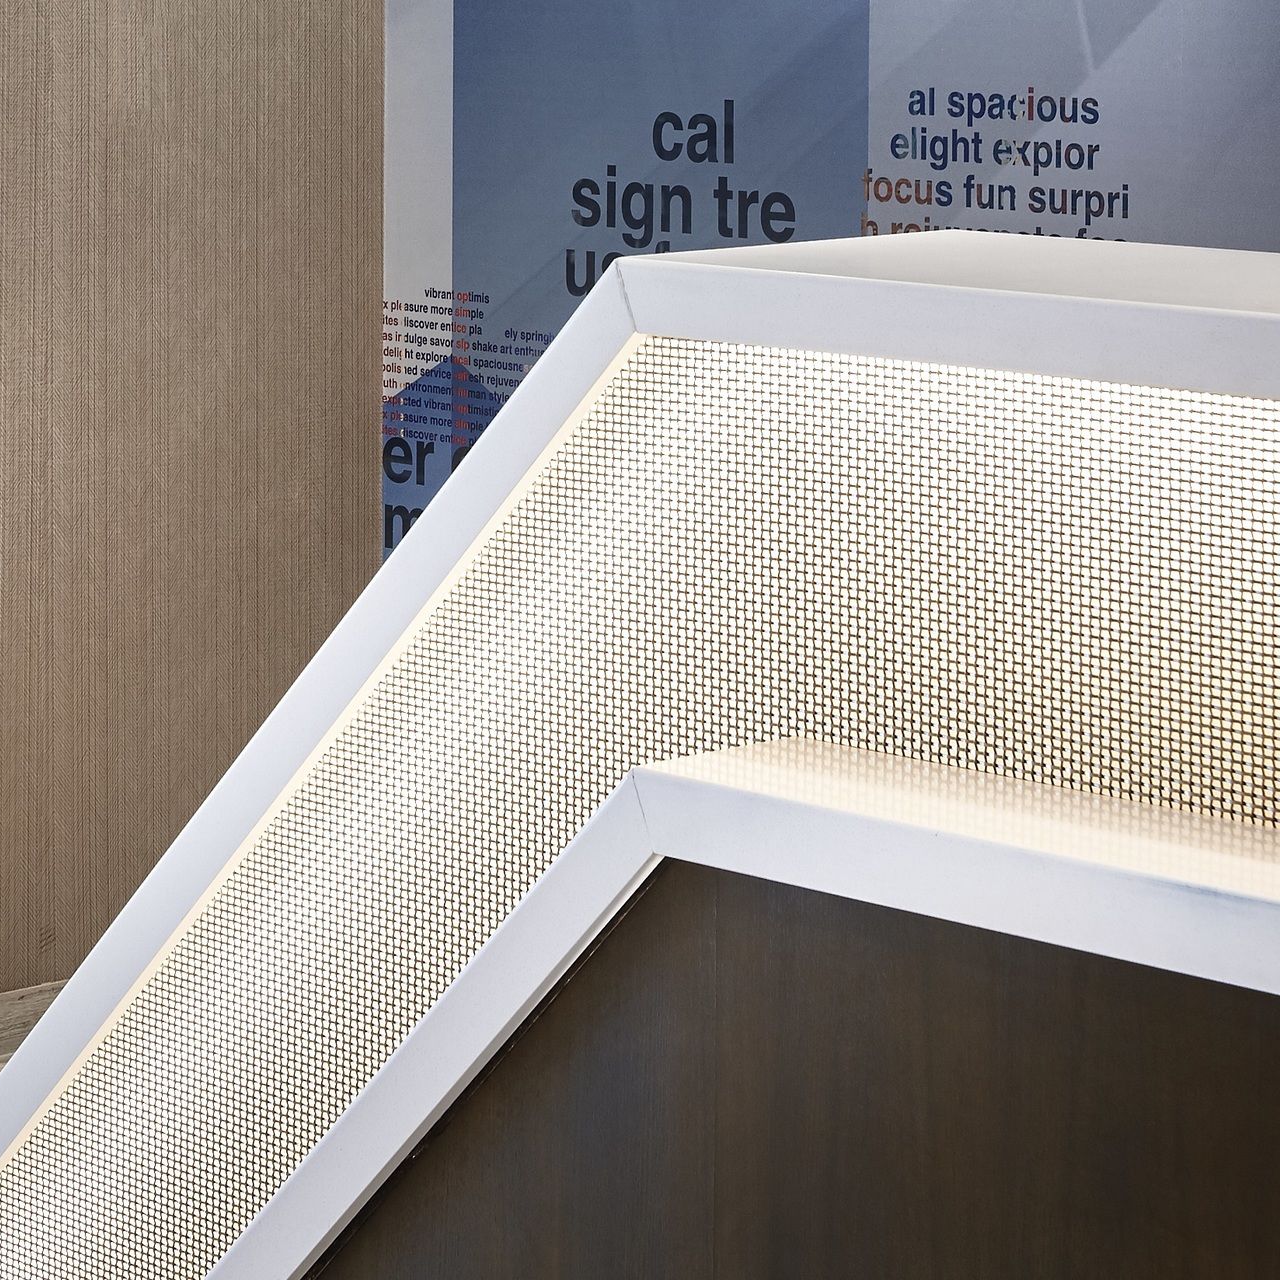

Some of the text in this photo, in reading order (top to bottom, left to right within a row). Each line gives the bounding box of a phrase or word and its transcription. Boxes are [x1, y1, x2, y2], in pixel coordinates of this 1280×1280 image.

[908, 86, 1100, 127] al spacious
[652, 99, 734, 164] cal
[890, 127, 1099, 177] elight explor
[860, 168, 1129, 226] focus fun surpri
[571, 165, 796, 248] sign tre
[424, 287, 490, 304] vibrant optimis
[431, 305, 453, 316] more
[454, 308, 484, 320] simple
[469, 324, 482, 336] pla
[504, 328, 518, 341] ely
[430, 337, 453, 348] savor
[456, 338, 470, 352] sip
[472, 340, 498, 354] shake
[500, 345, 513, 355] art
[416, 351, 448, 364] explore
[420, 368, 452, 380] service
[424, 398, 454, 412] vibrant
[431, 417, 453, 427] more
[383, 436, 435, 486] er
